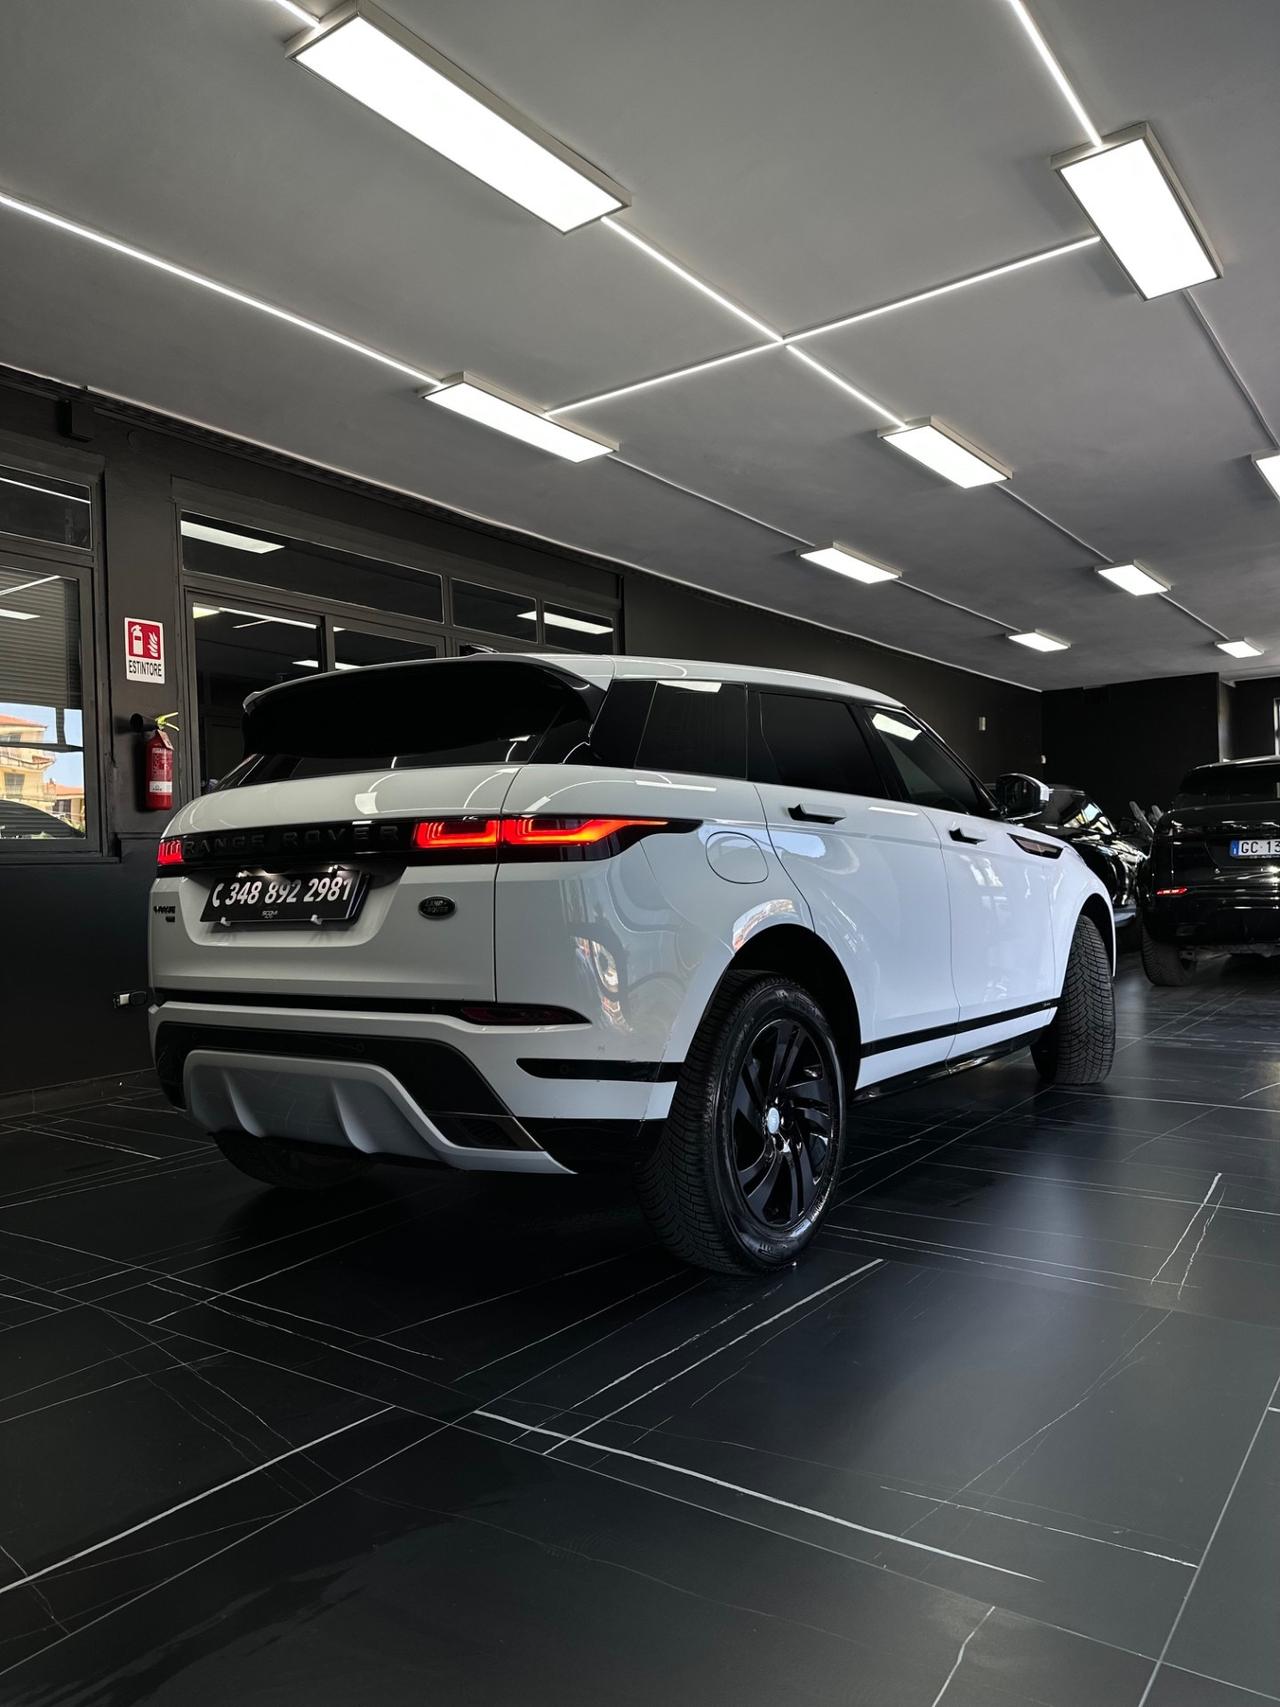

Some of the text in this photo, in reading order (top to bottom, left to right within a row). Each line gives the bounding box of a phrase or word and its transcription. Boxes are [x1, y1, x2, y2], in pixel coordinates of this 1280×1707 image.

[129, 660, 162, 677] ESTINTORE
[183, 825, 400, 854] RANGE ROVER
[225, 876, 353, 905] 348 892 2981
